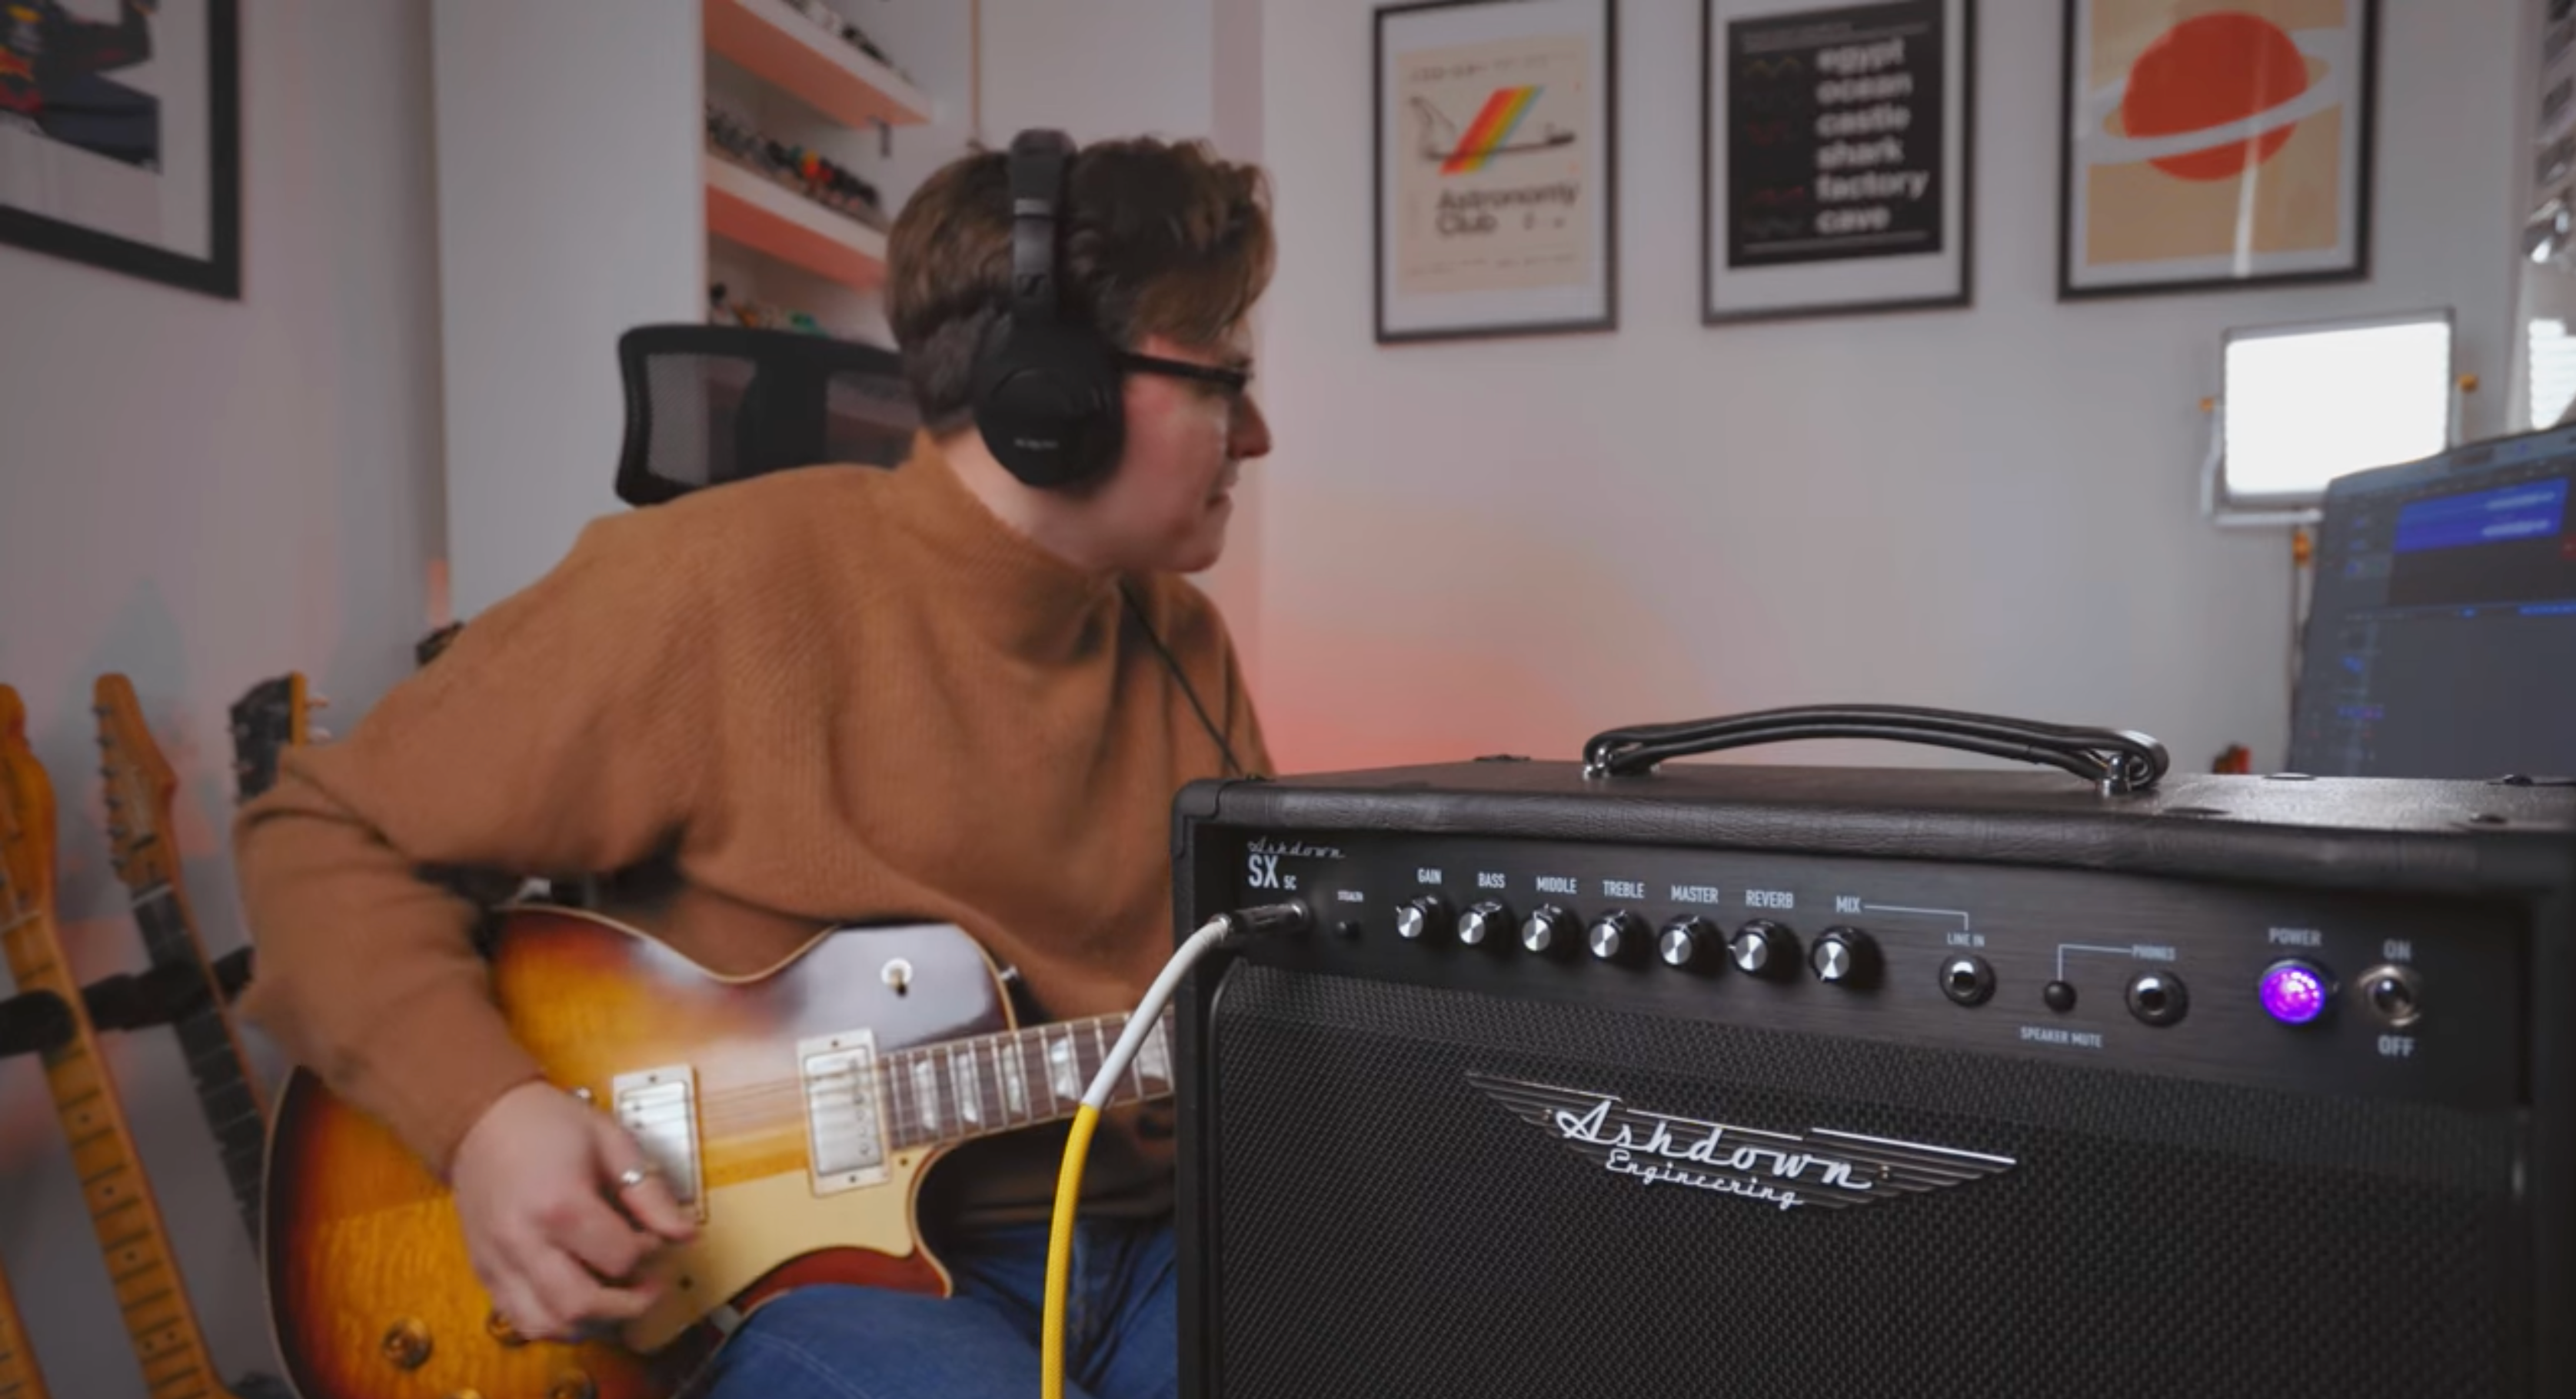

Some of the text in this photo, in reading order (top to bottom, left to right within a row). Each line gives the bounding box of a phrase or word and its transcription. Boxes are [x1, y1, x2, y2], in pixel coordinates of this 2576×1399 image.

[1816, 104, 1912, 137] castle
[1816, 206, 1890, 234] cave
[1247, 836, 1346, 859] Ashdown
[1248, 854, 1280, 889] SX
[1417, 868, 1443, 885] GAIN
[1478, 872, 1506, 889] BASS
[1536, 876, 1578, 895] MIDDLE
[1603, 880, 1645, 899] TREBLE
[1671, 885, 1719, 904] MASTER
[1746, 889, 1794, 909] REVERB
[1836, 896, 1861, 913] MIX
[1946, 932, 1985, 947] LINE IN
[2269, 927, 2321, 947] POWER
[2385, 939, 2411, 961] ON
[2020, 1026, 2102, 1048] SPEAKER MUTE
[2378, 1035, 2414, 1056] OFF
[1556, 1100, 1872, 1190] Ashdown
[1606, 1148, 1804, 1211] Engineering
